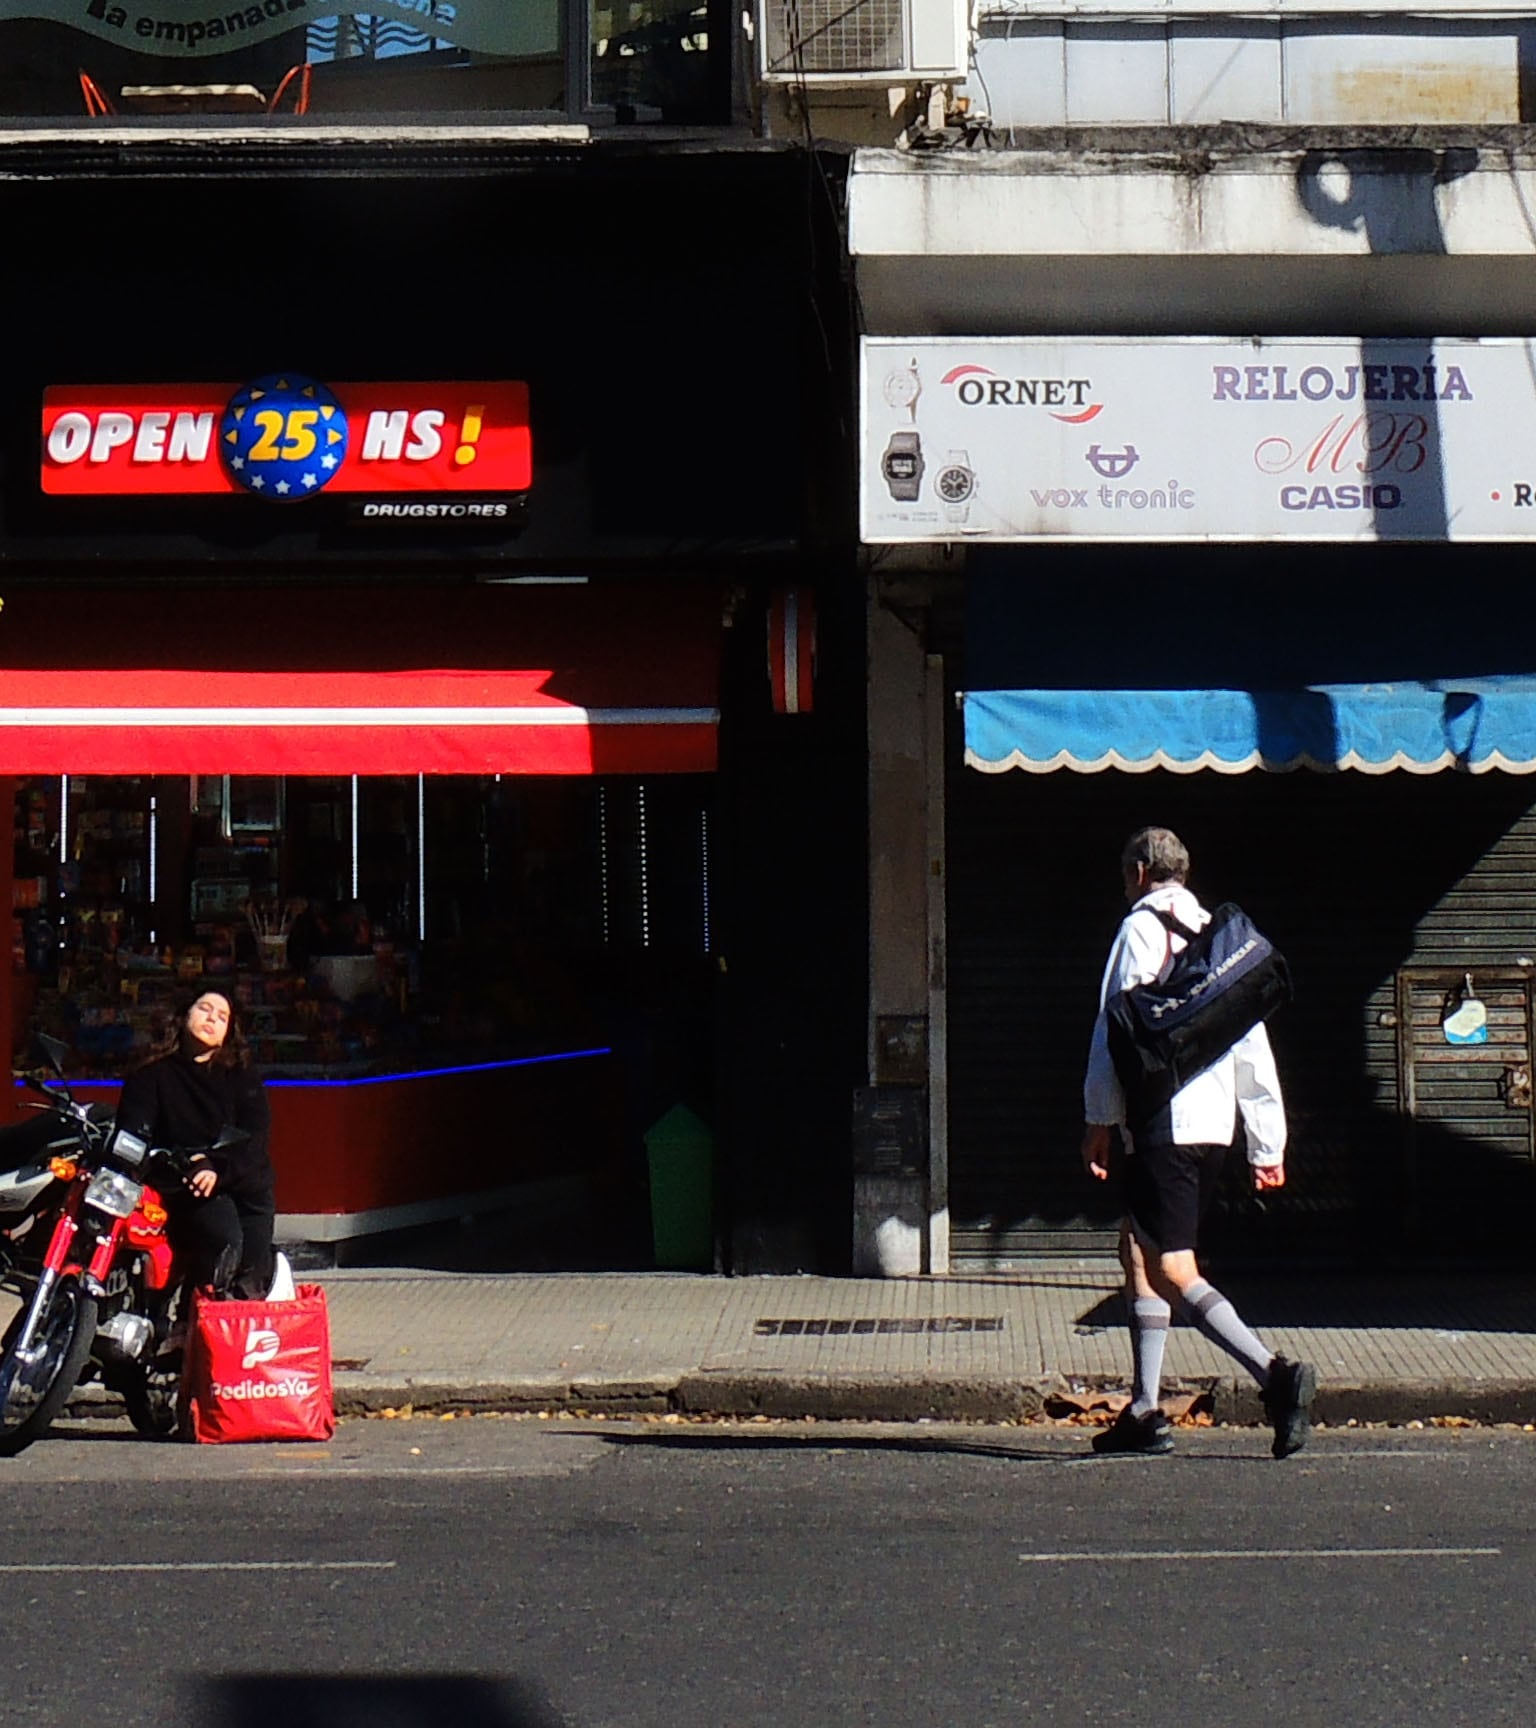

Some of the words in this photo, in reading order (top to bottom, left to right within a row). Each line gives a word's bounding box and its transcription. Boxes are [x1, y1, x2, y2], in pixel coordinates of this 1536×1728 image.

[1213, 354, 1473, 401] RELOJERÍA
[958, 379, 1093, 406] ORNET
[47, 411, 215, 463] OPEN
[248, 410, 321, 461] 25
[1029, 488, 1089, 508] vox
[1097, 479, 1196, 509] tronic
[1280, 484, 1402, 511] CASIO
[364, 503, 509, 518] DRUGSTORES
[210, 1376, 309, 1401] PedidosYa
